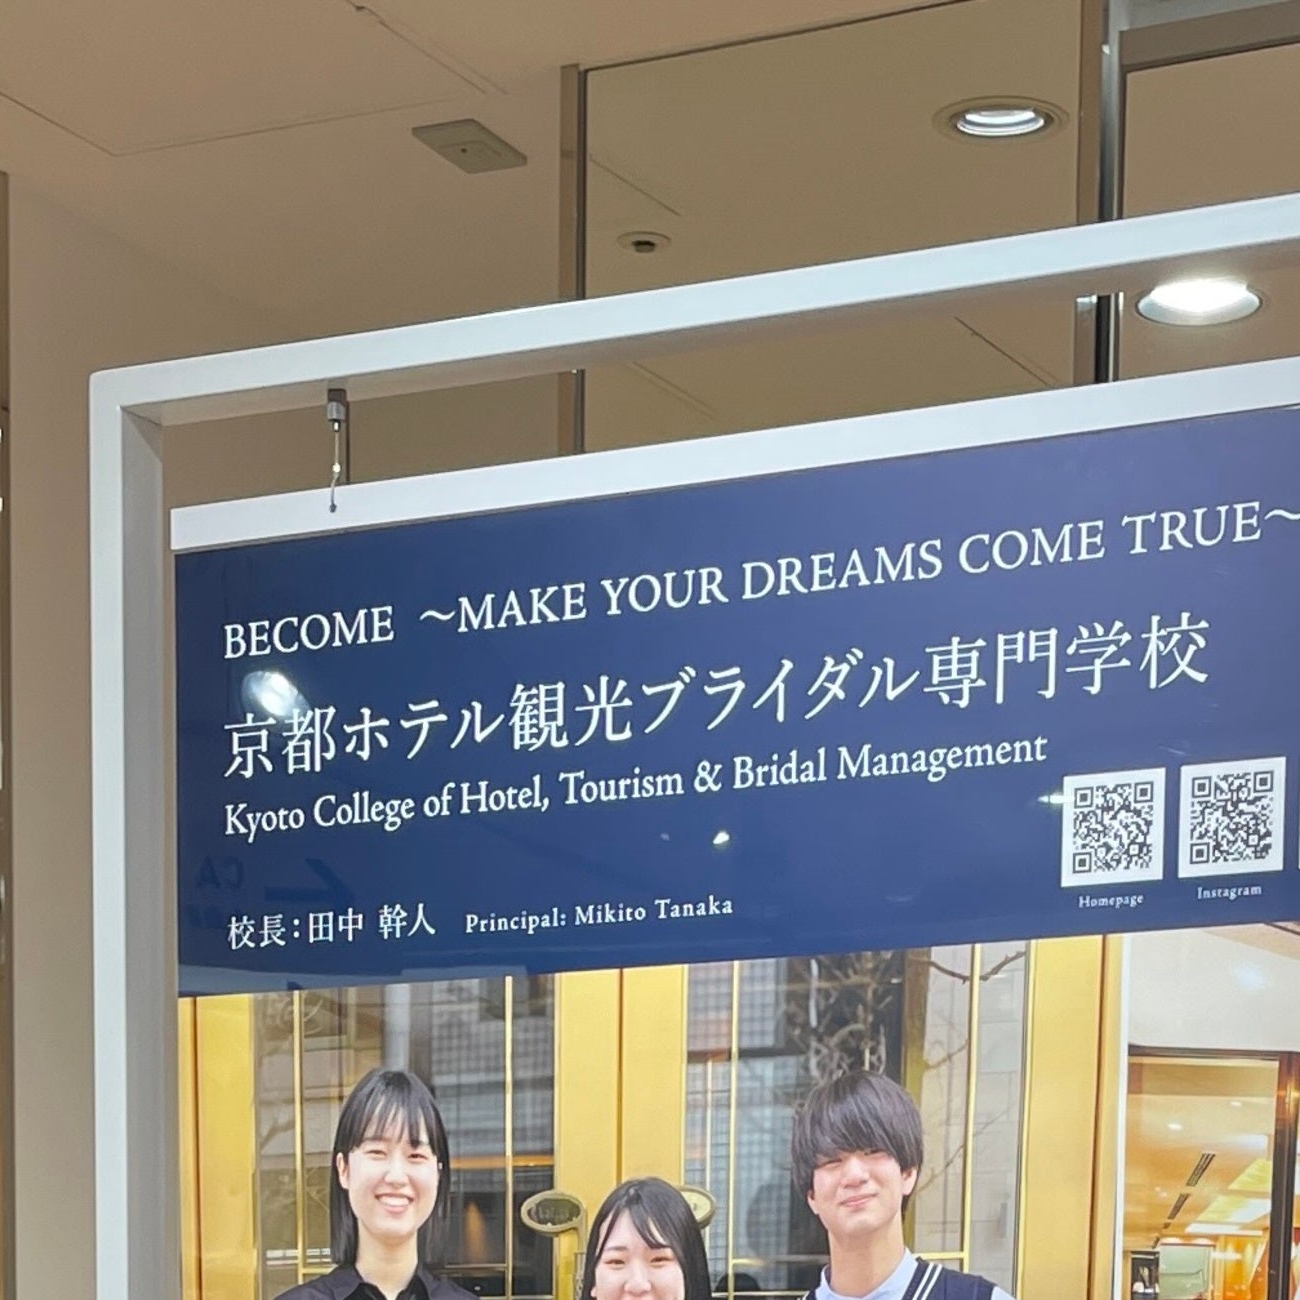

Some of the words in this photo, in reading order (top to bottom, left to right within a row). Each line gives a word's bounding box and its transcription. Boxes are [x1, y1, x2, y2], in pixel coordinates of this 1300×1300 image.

[223, 605, 395, 659] BECOME
[602, 566, 730, 615] YOUR
[741, 539, 944, 600] DREAMS
[957, 519, 1105, 575] COME
[223, 610, 1212, 780] 京都ホテル観光ブライダル専門学校
[224, 803, 305, 844] Kyoto
[312, 784, 416, 832] College
[422, 779, 456, 817] of
[459, 774, 551, 816] Hotel,
[558, 768, 685, 807] Tourism
[694, 761, 723, 793] &
[733, 749, 827, 790] Bridal
[836, 735, 1048, 783] Management
[1077, 891, 1144, 911] Homepage
[1196, 882, 1263, 902] Instagram
[377, 902, 436, 940] 幹人
[464, 909, 567, 935] Principal:
[574, 902, 648, 926] Mikito
[654, 895, 734, 920] Tanaka
